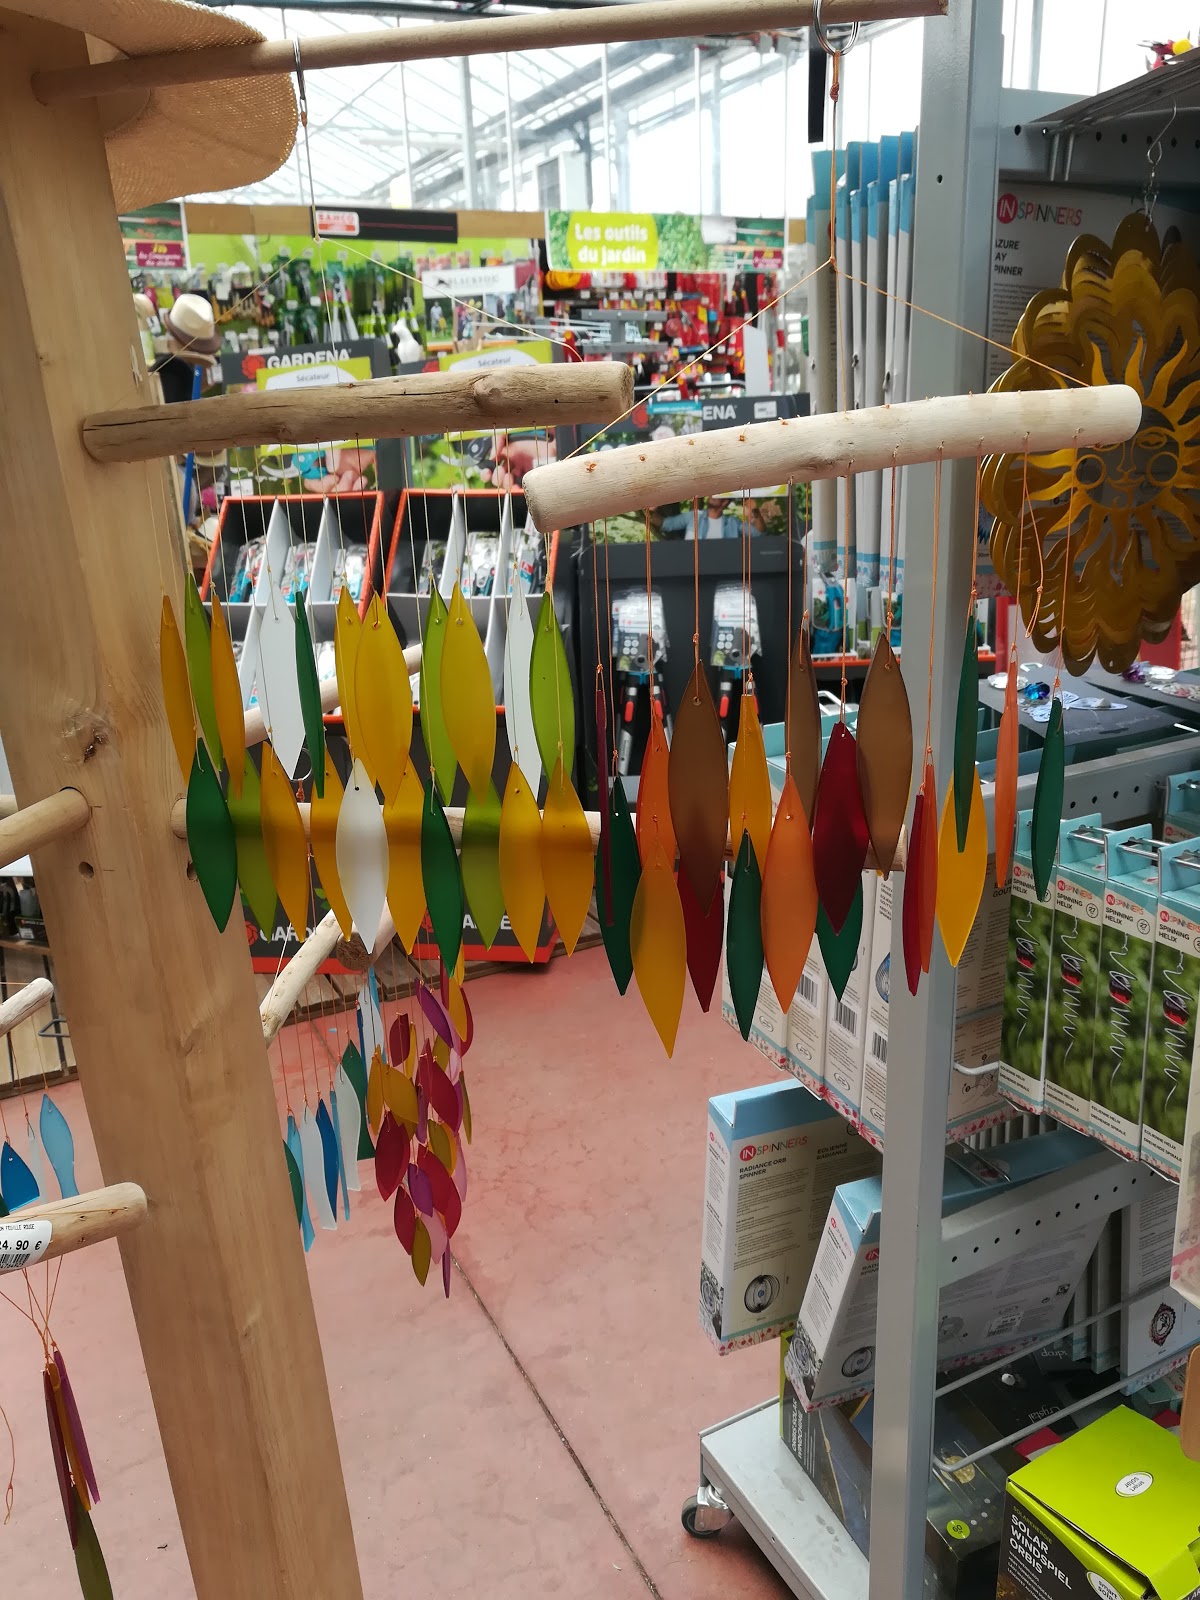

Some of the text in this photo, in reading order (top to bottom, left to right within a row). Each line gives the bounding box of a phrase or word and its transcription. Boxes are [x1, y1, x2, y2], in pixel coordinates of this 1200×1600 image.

[574, 223, 648, 242] Les outils
[578, 245, 646, 267] du jardin
[267, 348, 350, 369] GARDENA
[1013, 885, 1028, 895] HELIX
[1056, 900, 1073, 911] HELIX
[1057, 892, 1083, 907] SPINNING
[1105, 907, 1133, 922] SPINNING
[1105, 914, 1123, 925] HELIX
[1158, 931, 1178, 943] HELIX
[1159, 924, 1190, 940] SPINNING
[816, 1148, 848, 1160] RADIANCE
[739, 1157, 787, 1174] RADIANCE ORB
[739, 1168, 767, 1180] SPINNER
[1028, 1404, 1060, 1424] Crystal
[1011, 1514, 1049, 1554] SOLAR
[1009, 1537, 1043, 1574] ORBIS
[1010, 1525, 1072, 1590] WINDSPIEL
